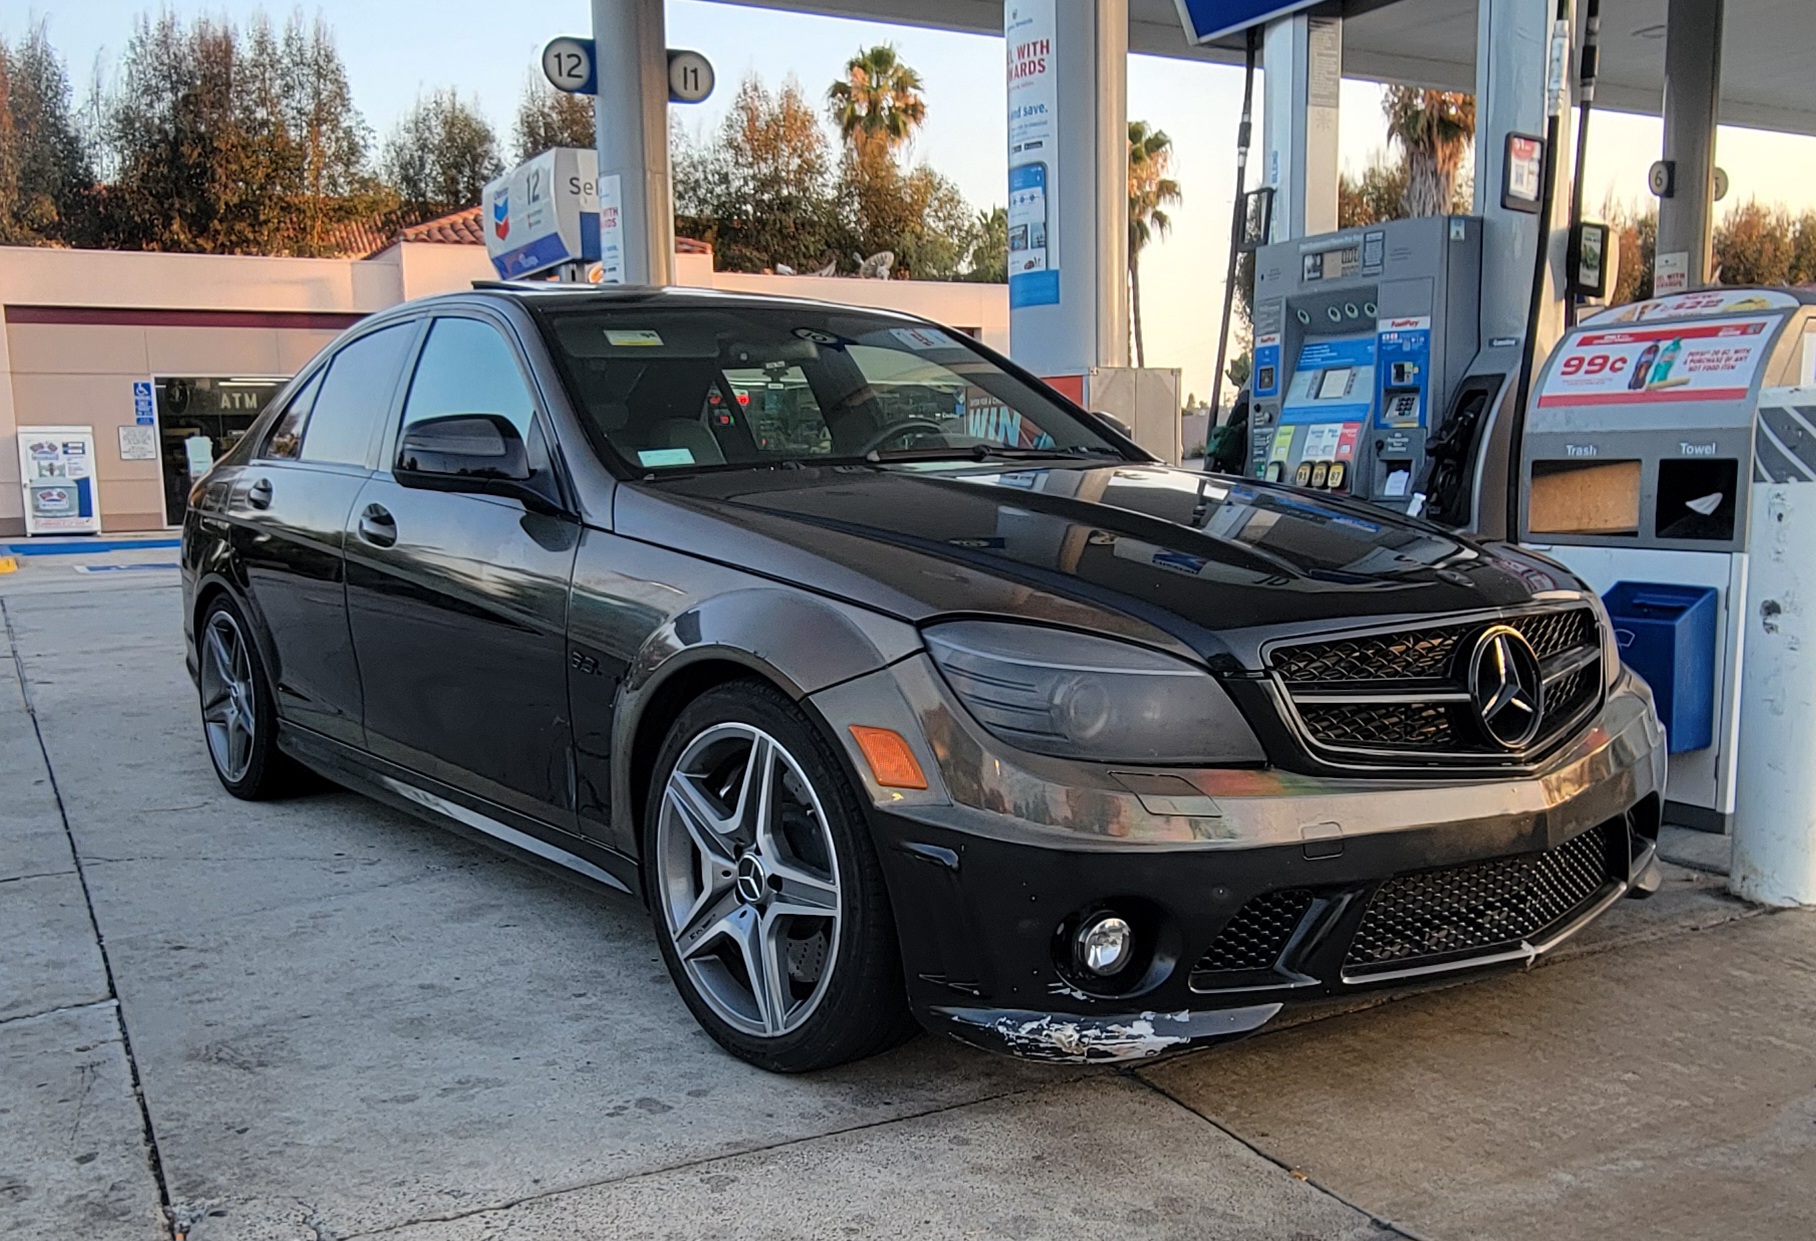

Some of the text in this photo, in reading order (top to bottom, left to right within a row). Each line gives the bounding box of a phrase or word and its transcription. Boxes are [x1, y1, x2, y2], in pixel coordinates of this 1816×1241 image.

[1017, 39, 1050, 61] WITH
[553, 52, 583, 79] 12
[682, 66, 699, 91] 11
[1023, 103, 1048, 117] save.
[526, 168, 540, 205] 12
[1655, 171, 1663, 187] 6
[1734, 347, 1751, 355] WITH
[1734, 355, 1748, 363] ANY
[1702, 363, 1720, 371] FOOD
[220, 392, 258, 409] ATM
[969, 406, 1021, 447] WIN
[1566, 445, 1597, 456] Trash
[1680, 443, 1716, 455] Towel
[1330, 472, 1340, 481] 87
